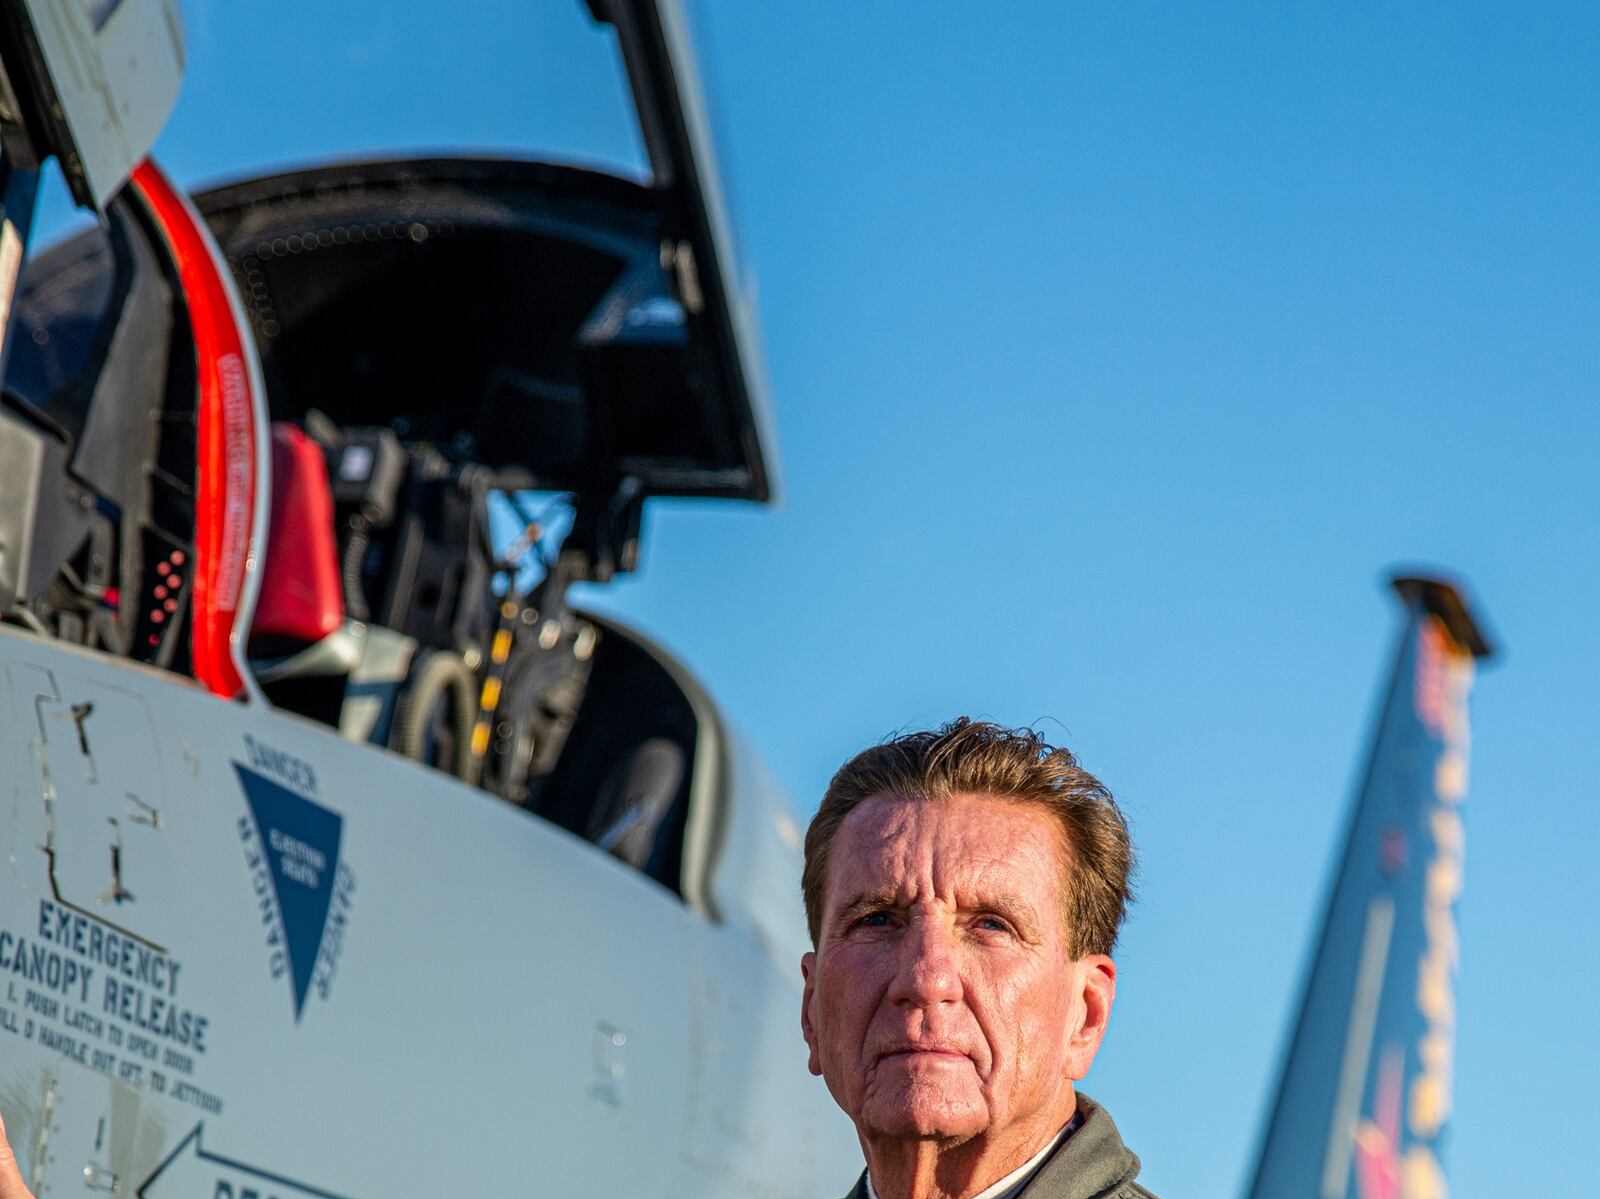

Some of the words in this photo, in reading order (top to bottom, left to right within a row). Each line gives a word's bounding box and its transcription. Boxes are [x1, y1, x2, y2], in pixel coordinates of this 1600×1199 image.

[242, 733, 318, 795] DANGER
[39, 898, 181, 997] EMERGENCY
[0, 929, 93, 1003] CANOPY
[103, 974, 209, 1053] RELEASE
[24, 990, 58, 1020] PUSH
[64, 1004, 103, 1039] LATCH
[107, 1022, 124, 1048] TO
[127, 1033, 158, 1062] OPEN
[38, 1024, 88, 1064] HANDLE
[92, 1049, 116, 1074] OUT
[150, 1070, 166, 1093] TO
